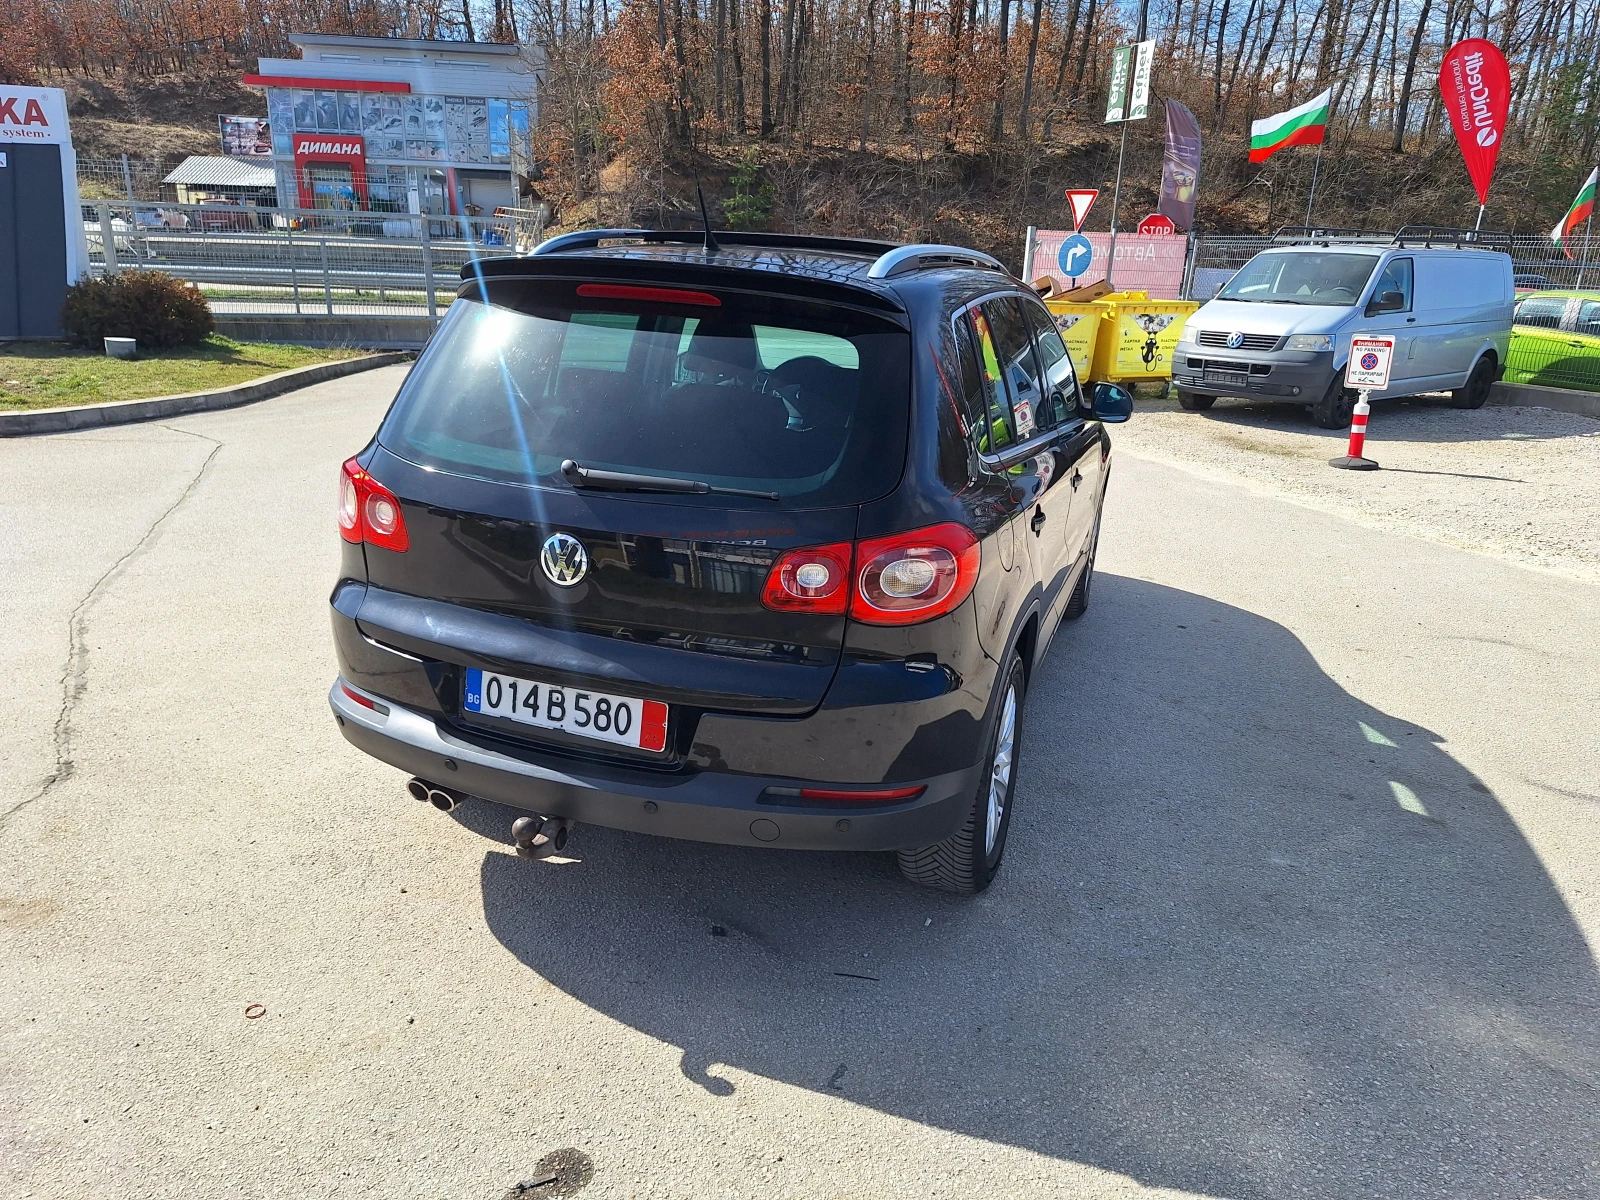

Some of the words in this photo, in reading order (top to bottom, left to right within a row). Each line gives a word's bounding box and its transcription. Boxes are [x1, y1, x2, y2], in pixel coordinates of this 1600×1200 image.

[1110, 51, 1124, 103] efbet
[1135, 46, 1148, 99] efbet
[2, 129, 45, 139] system
[297, 141, 361, 155] ДИМАНА
[1141, 225, 1171, 235] STOP
[467, 692, 480, 705] BG
